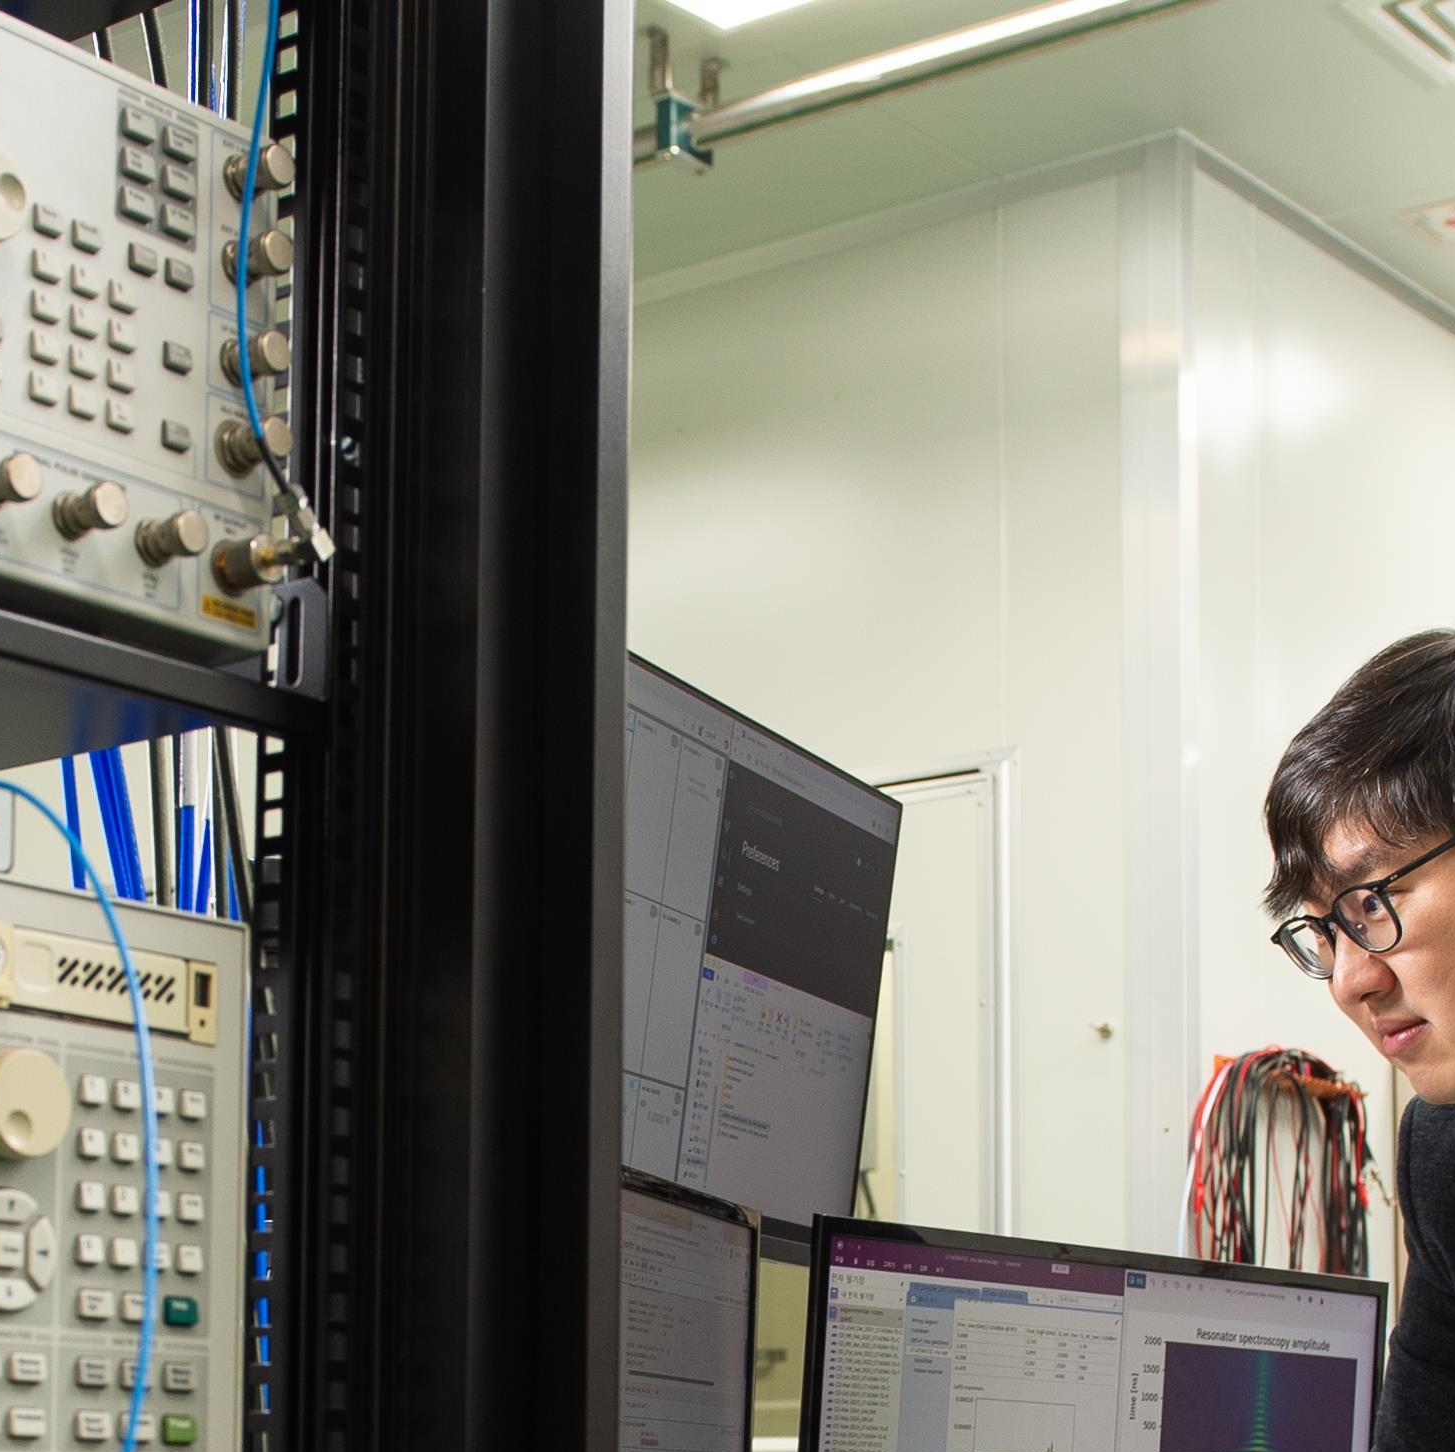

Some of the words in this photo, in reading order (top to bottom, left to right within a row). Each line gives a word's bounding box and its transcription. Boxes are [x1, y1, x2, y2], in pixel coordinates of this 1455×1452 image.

[741, 840, 781, 872] Preferences
[1144, 1335, 1162, 1346] 2000
[1196, 1328, 1237, 1342] Resonator
[1239, 1332, 1290, 1350] spectroscopy
[1292, 1336, 1330, 1351] amplitude
[1143, 1364, 1160, 1374] 1500
[1141, 1392, 1158, 1402] 1000
[1129, 1396, 1137, 1420] time
[1143, 1421, 1156, 1431] 500
